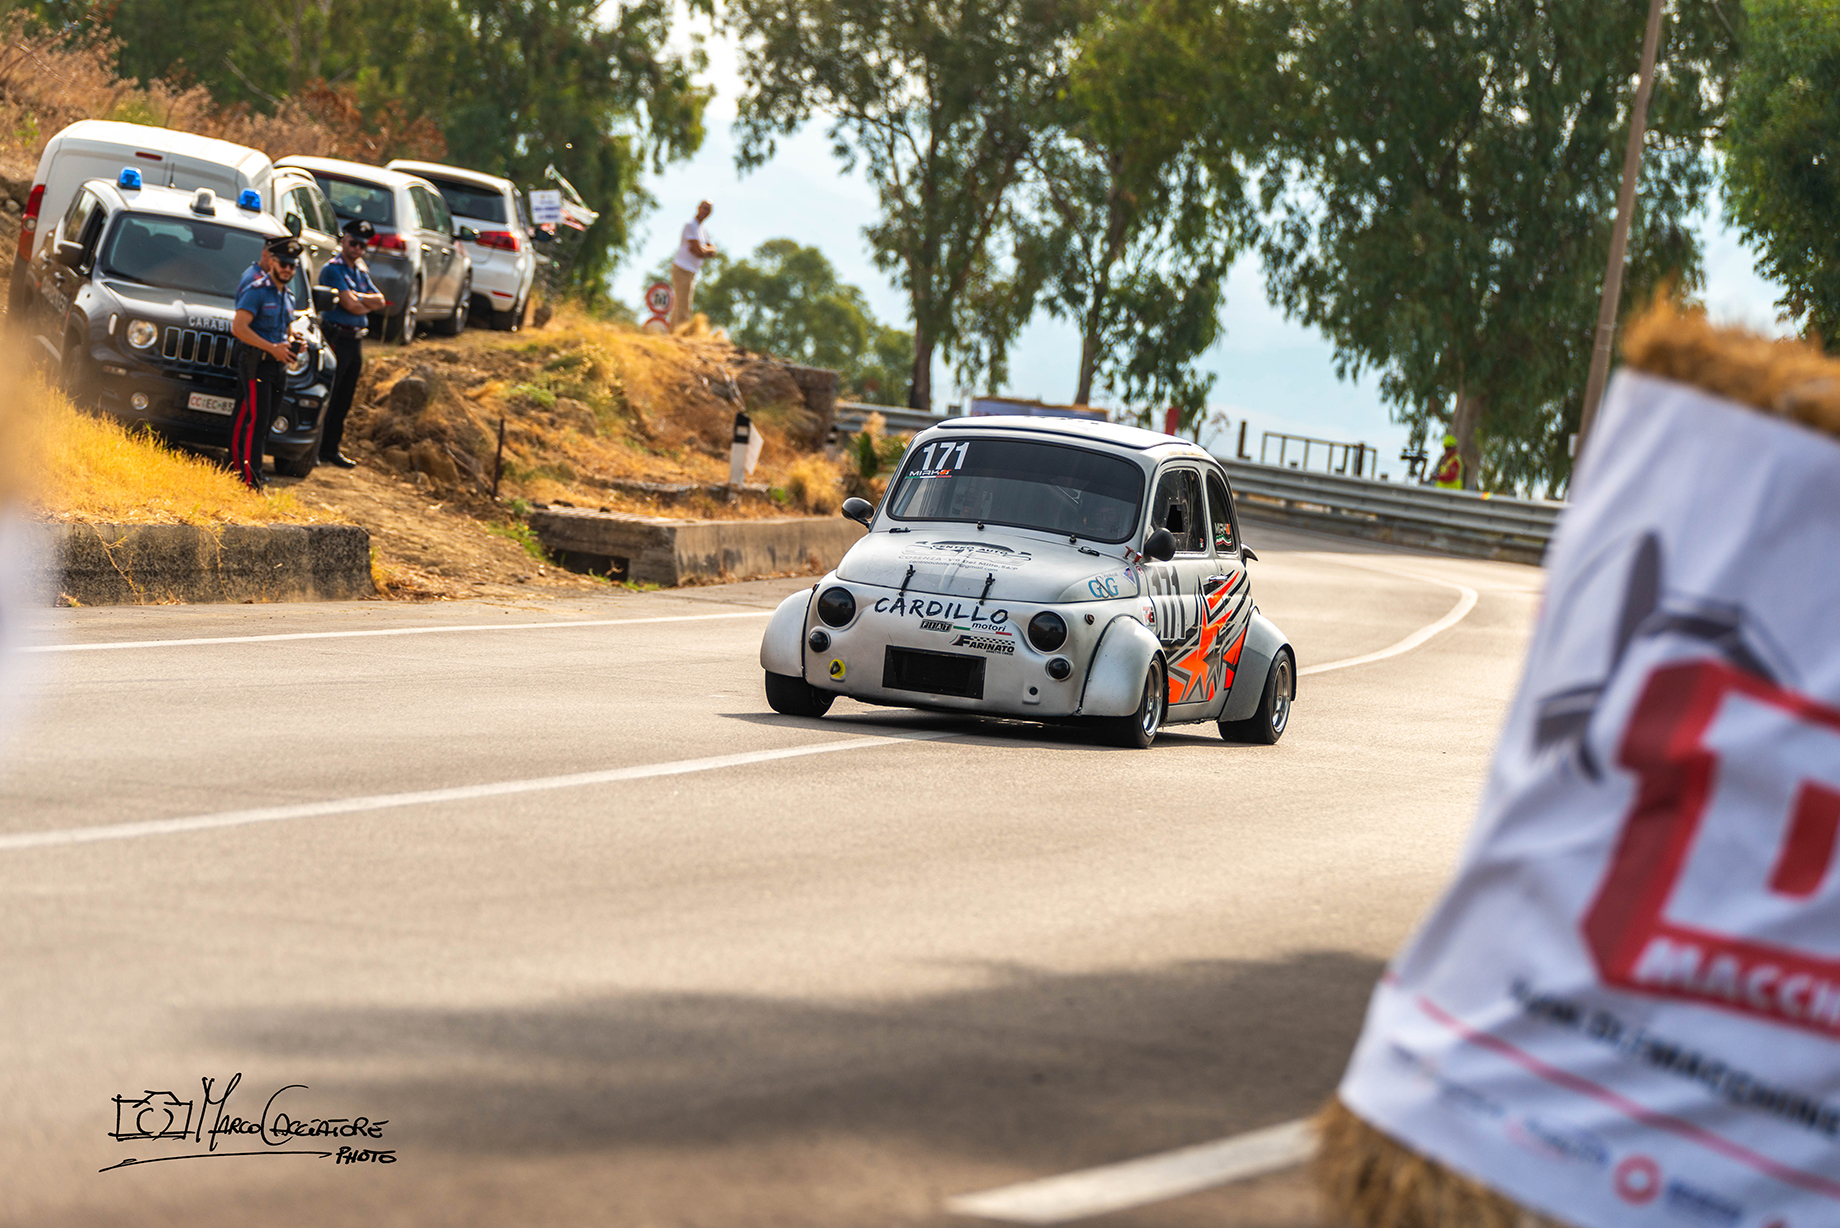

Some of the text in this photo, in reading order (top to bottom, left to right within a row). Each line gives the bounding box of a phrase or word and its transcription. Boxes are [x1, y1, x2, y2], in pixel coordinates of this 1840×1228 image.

[188, 316, 233, 332] CARABI
[190, 396, 202, 407] CC
[206, 398, 218, 410] EC
[922, 442, 970, 470] 171
[932, 544, 1008, 557] CENTRO AUTO
[874, 597, 1009, 624] CARDILLO
[1150, 566, 1186, 640] 171
[921, 621, 951, 632] FIAT
[972, 622, 1006, 632] motori
[952, 635, 1015, 653] FARINATO
